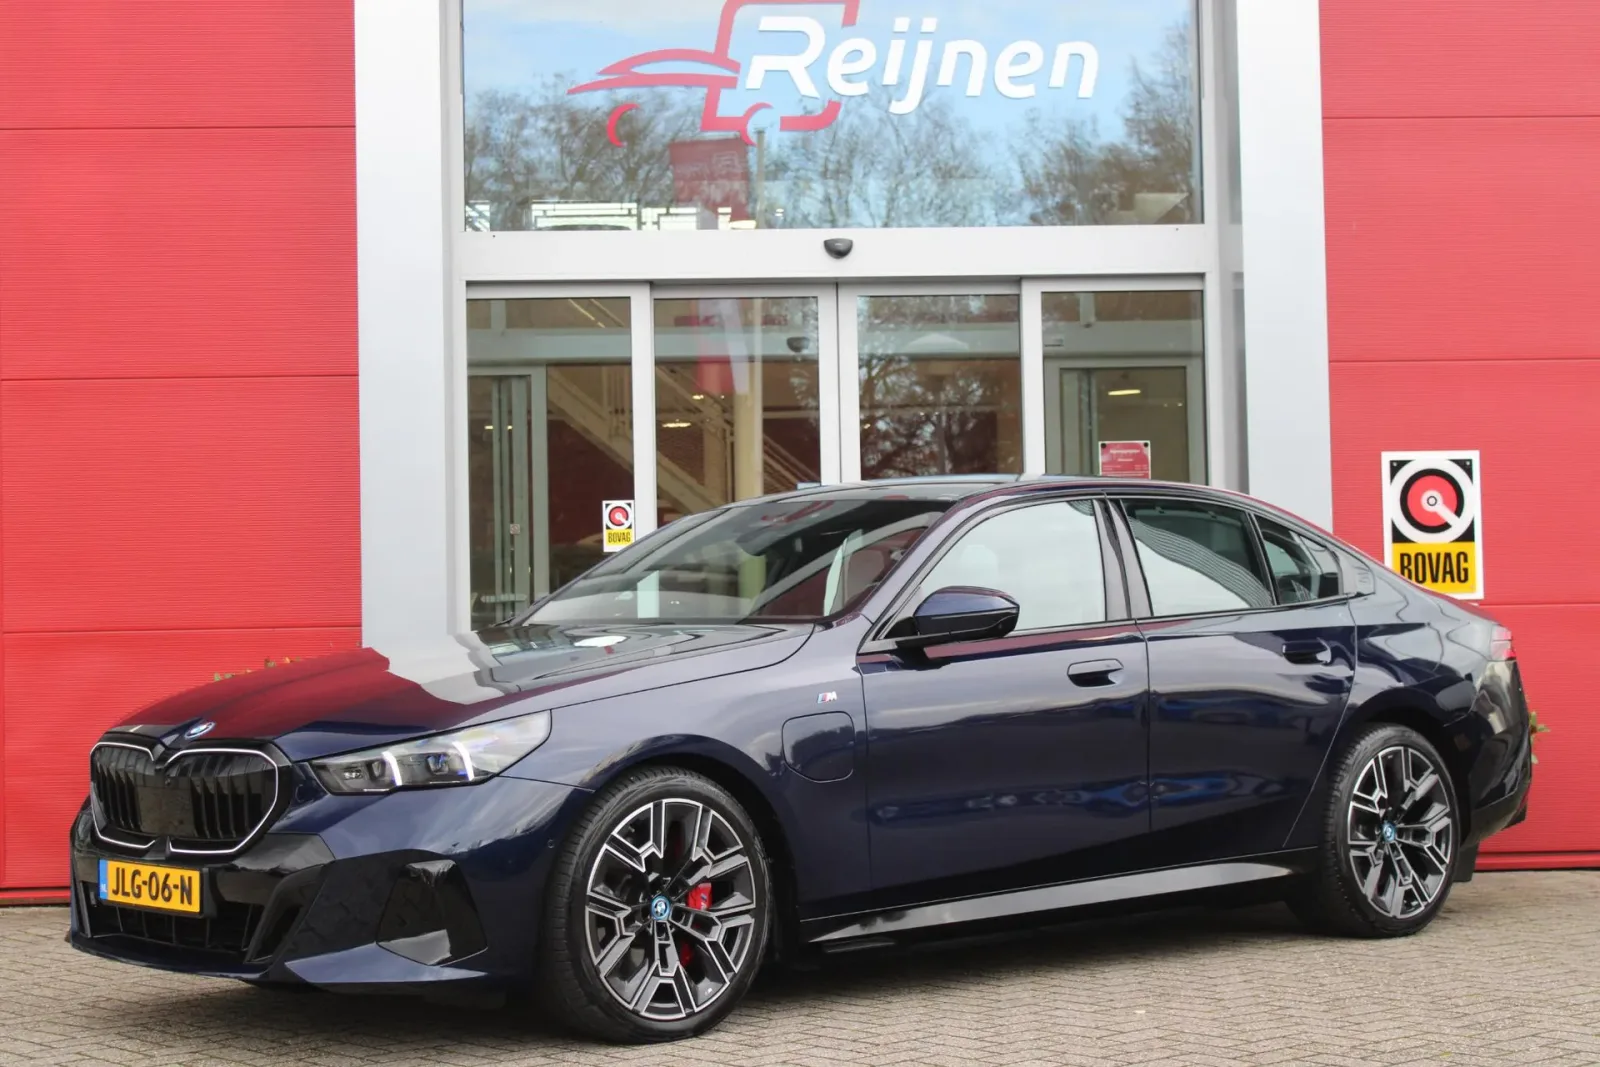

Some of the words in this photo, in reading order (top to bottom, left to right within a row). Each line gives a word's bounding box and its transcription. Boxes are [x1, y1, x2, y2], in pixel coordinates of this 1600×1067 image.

[745, 16, 1099, 115] Reijnen
[608, 532, 630, 542] BOVAG
[1400, 551, 1469, 584] BOVAG
[112, 867, 192, 905] JLG-06-N
